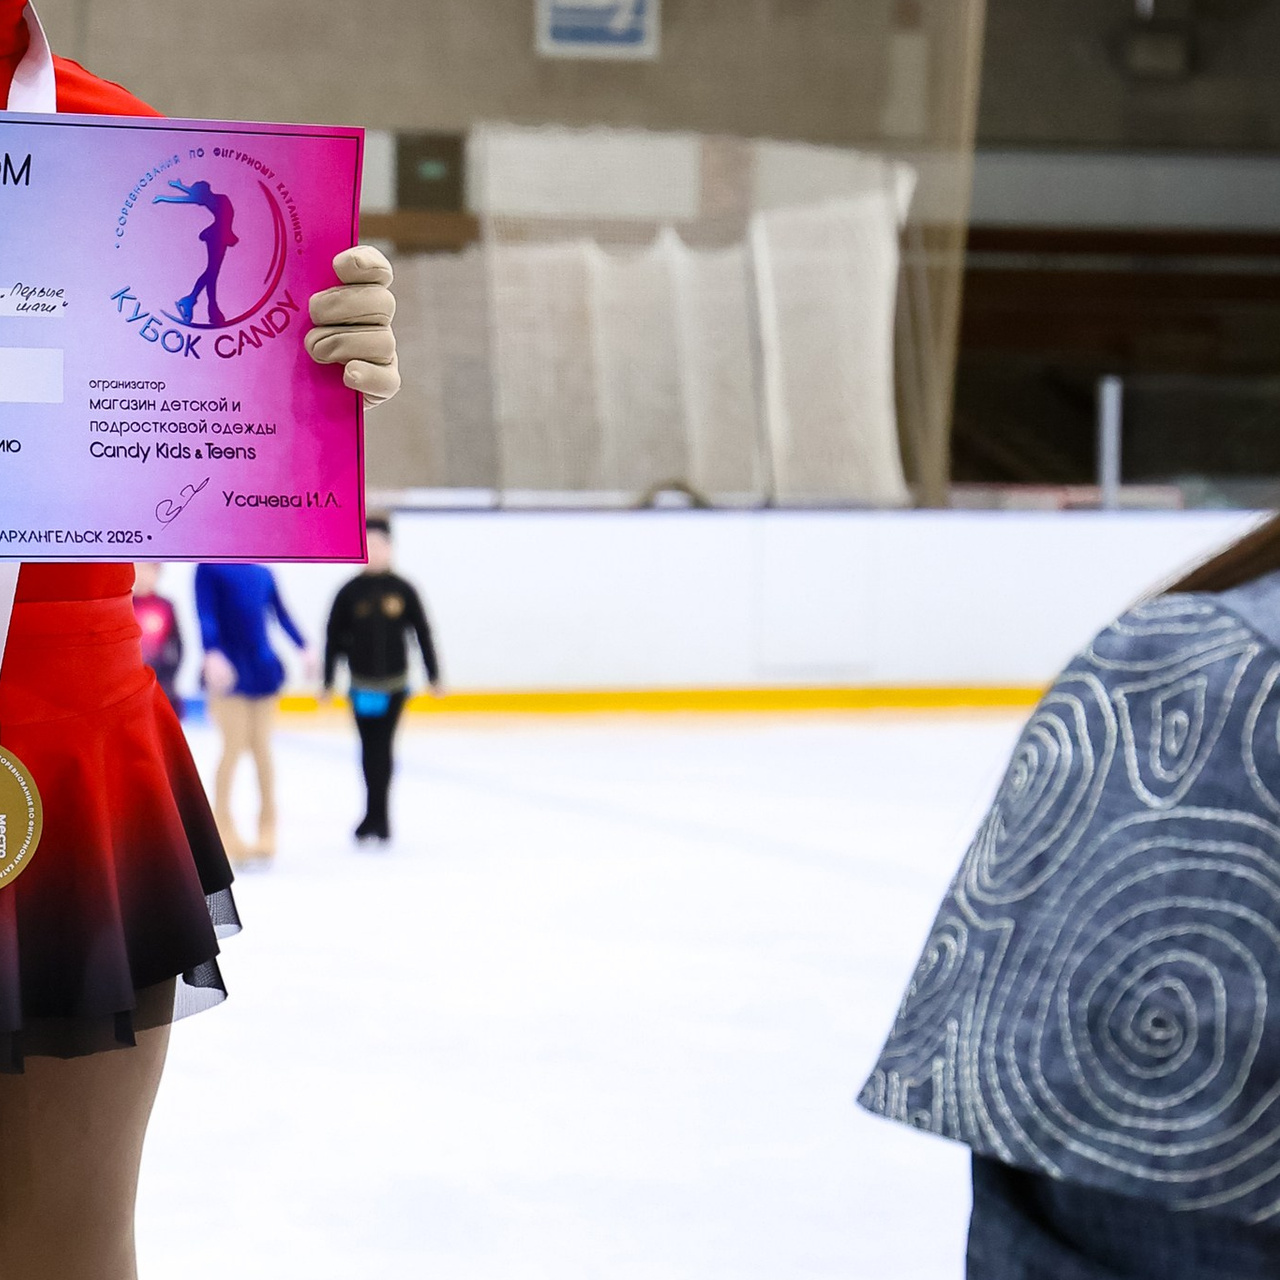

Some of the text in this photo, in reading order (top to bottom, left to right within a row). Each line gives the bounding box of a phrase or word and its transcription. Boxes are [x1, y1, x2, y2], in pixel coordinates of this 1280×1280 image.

[189, 147, 205, 159] ПО
[213, 147, 275, 179] ФИГУРНОМУ
[276, 182, 303, 243] КАТАНИЮ
[110, 285, 301, 359] КУБОК CANDY
[88, 379, 166, 392] огранизатор
[89, 397, 241, 412] магазин детской и
[89, 419, 277, 436] подростковой одежды
[89, 441, 257, 464] Candy Kids & Teens
[222, 490, 302, 508] Усачева
[106, 530, 144, 543] 2025
[28, 807, 35, 819] ПО
[13, 820, 35, 865] ФИГУРНОМУ
